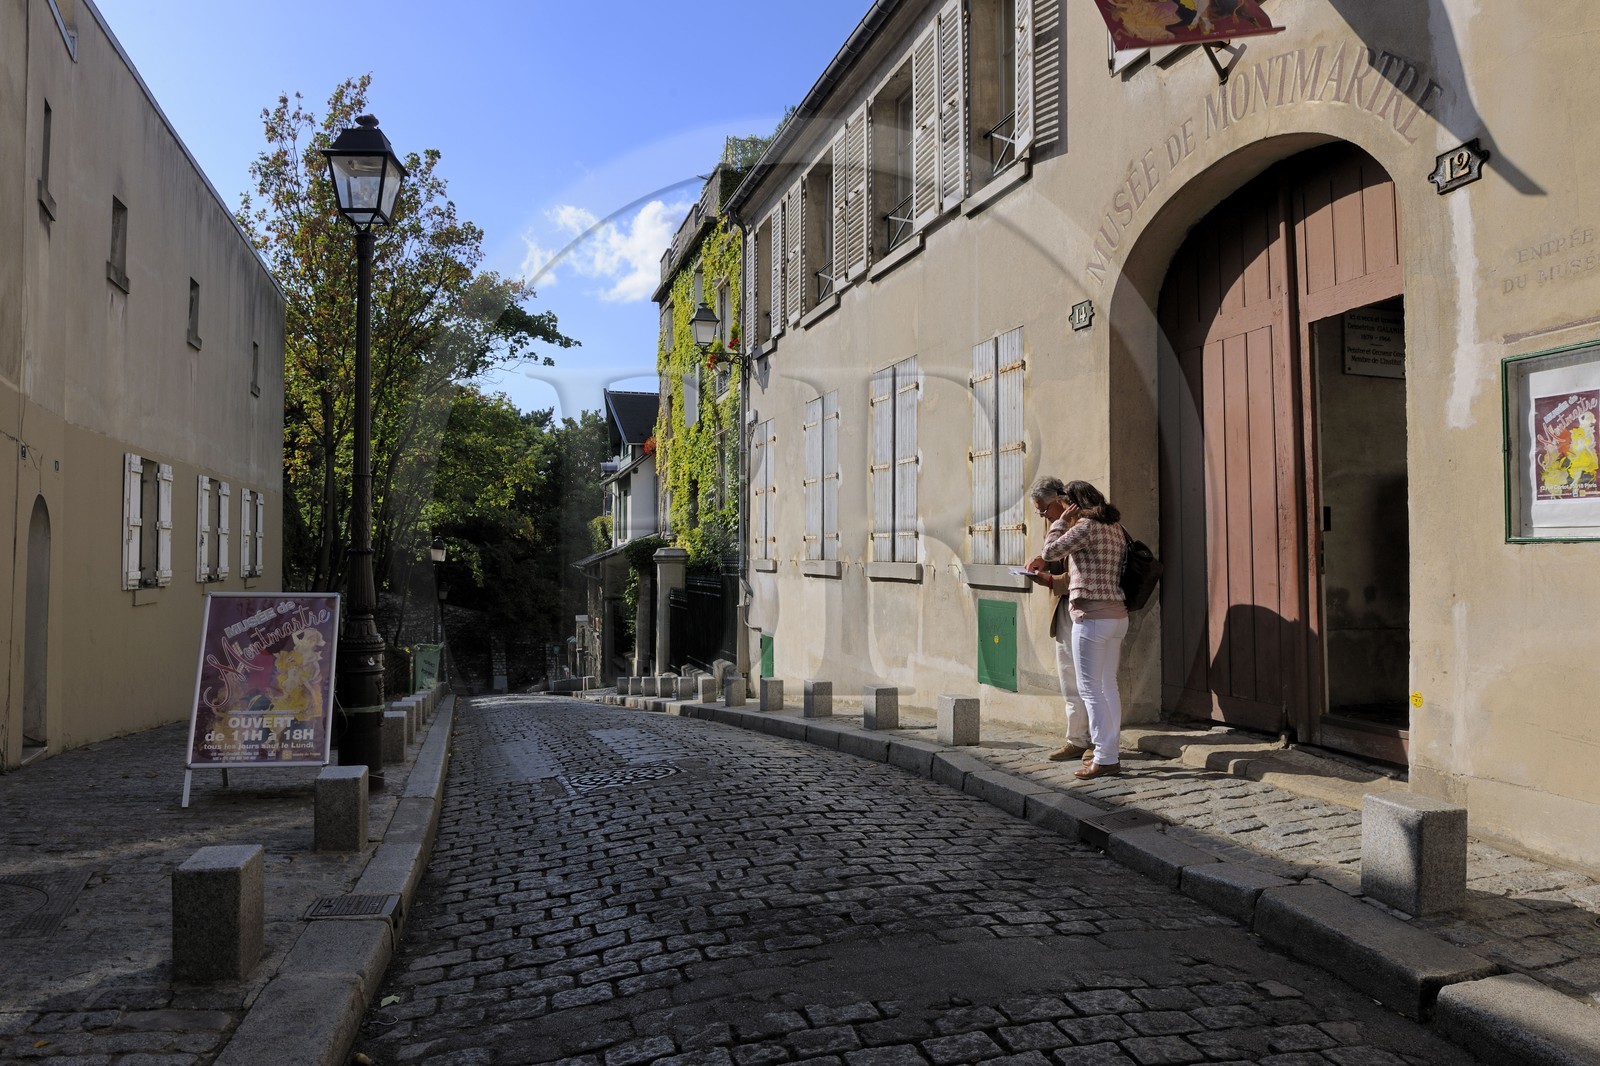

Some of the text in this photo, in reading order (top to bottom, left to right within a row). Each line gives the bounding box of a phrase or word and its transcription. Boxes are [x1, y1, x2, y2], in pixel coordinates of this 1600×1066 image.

[1086, 40, 1443, 287] MUSÉE DE MONTMARTRE
[1444, 151, 1472, 183] 12
[1503, 273, 1527, 295] DU
[1075, 306, 1087, 324] 14
[224, 601, 296, 638] MUSÉE de
[203, 605, 330, 708] Montmartre
[228, 717, 295, 728] OUVERT
[204, 731, 225, 742] de
[232, 730, 263, 741] 11H
[284, 729, 314, 740] 18H
[238, 743, 259, 751] jours
[291, 741, 314, 749] Lundi
